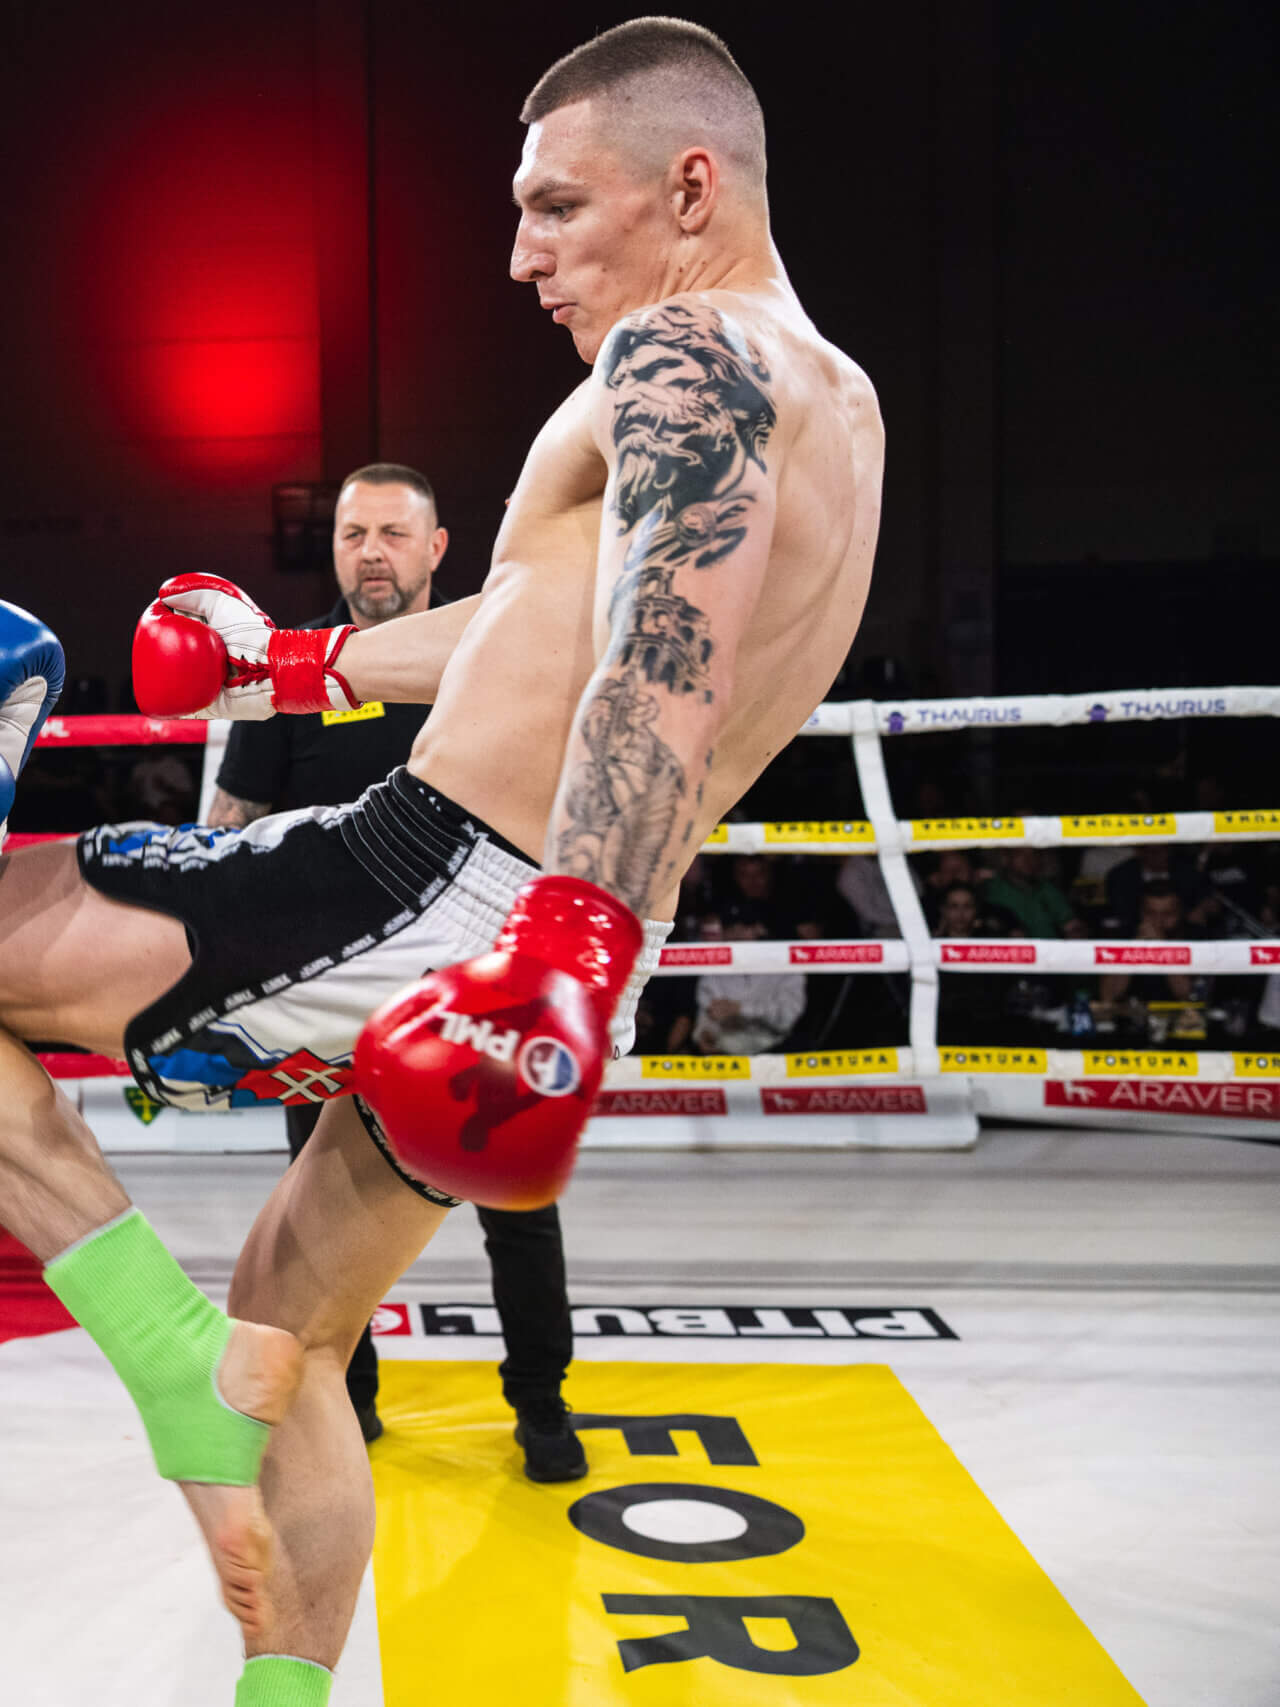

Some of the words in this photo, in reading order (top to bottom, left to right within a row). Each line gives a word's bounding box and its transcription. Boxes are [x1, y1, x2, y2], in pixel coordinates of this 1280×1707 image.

[917, 707, 1022, 723] THAURUS
[1121, 699, 1227, 716] THAURUS
[41, 719, 70, 738] ML
[664, 948, 731, 964] ARAVER
[814, 946, 880, 962] ARAVER
[968, 948, 1034, 963] ARAVER
[1121, 949, 1188, 964] ARAVER
[437, 1011, 521, 1062] PML
[651, 1060, 742, 1072] FORTUNA
[795, 1054, 889, 1069] FORTUNA
[943, 1052, 1037, 1066] FORTUNA
[1092, 1055, 1188, 1068] FORTUNA
[610, 1092, 720, 1112] ARAVER
[807, 1090, 920, 1110] ARAVER
[1109, 1080, 1273, 1113] ARAVER
[434, 1306, 940, 1338] PITBUL
